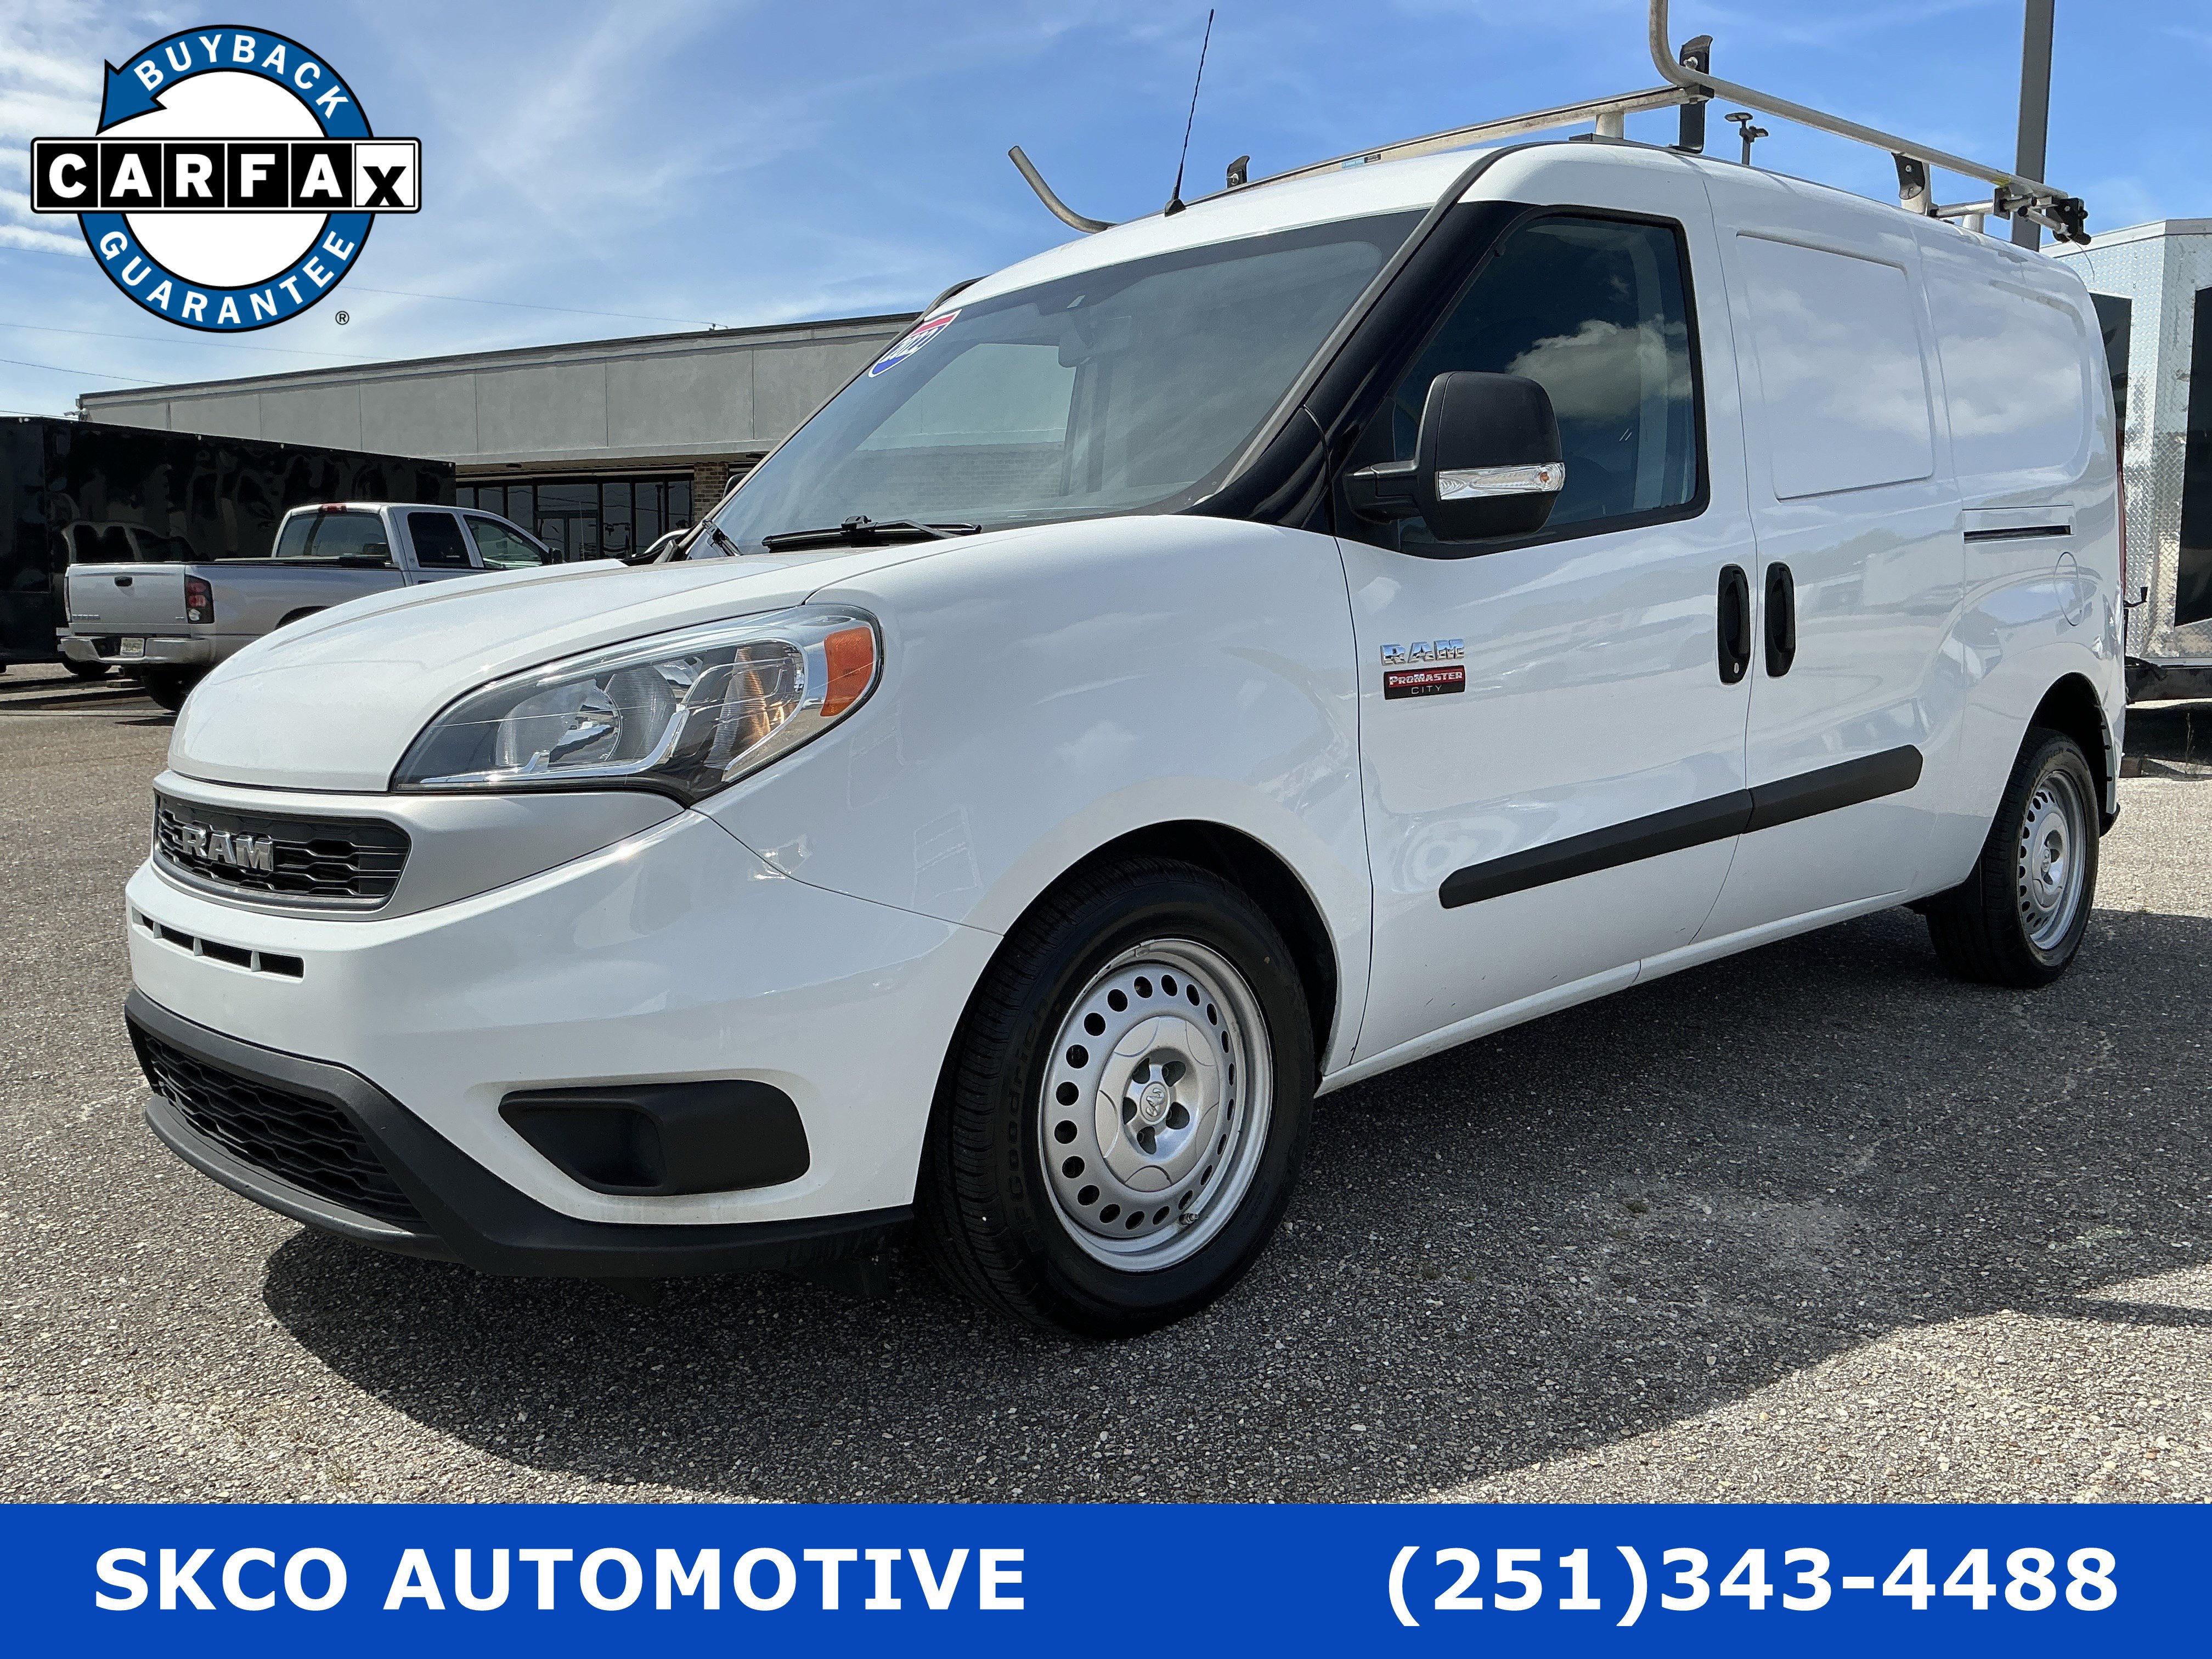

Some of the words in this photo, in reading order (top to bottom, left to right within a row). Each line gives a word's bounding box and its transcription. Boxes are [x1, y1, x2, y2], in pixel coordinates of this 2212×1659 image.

[878, 327, 939, 364] 2022
[1380, 638, 1465, 666] RAM
[1411, 685, 1443, 695] CITY
[182, 824, 274, 872] RAM
